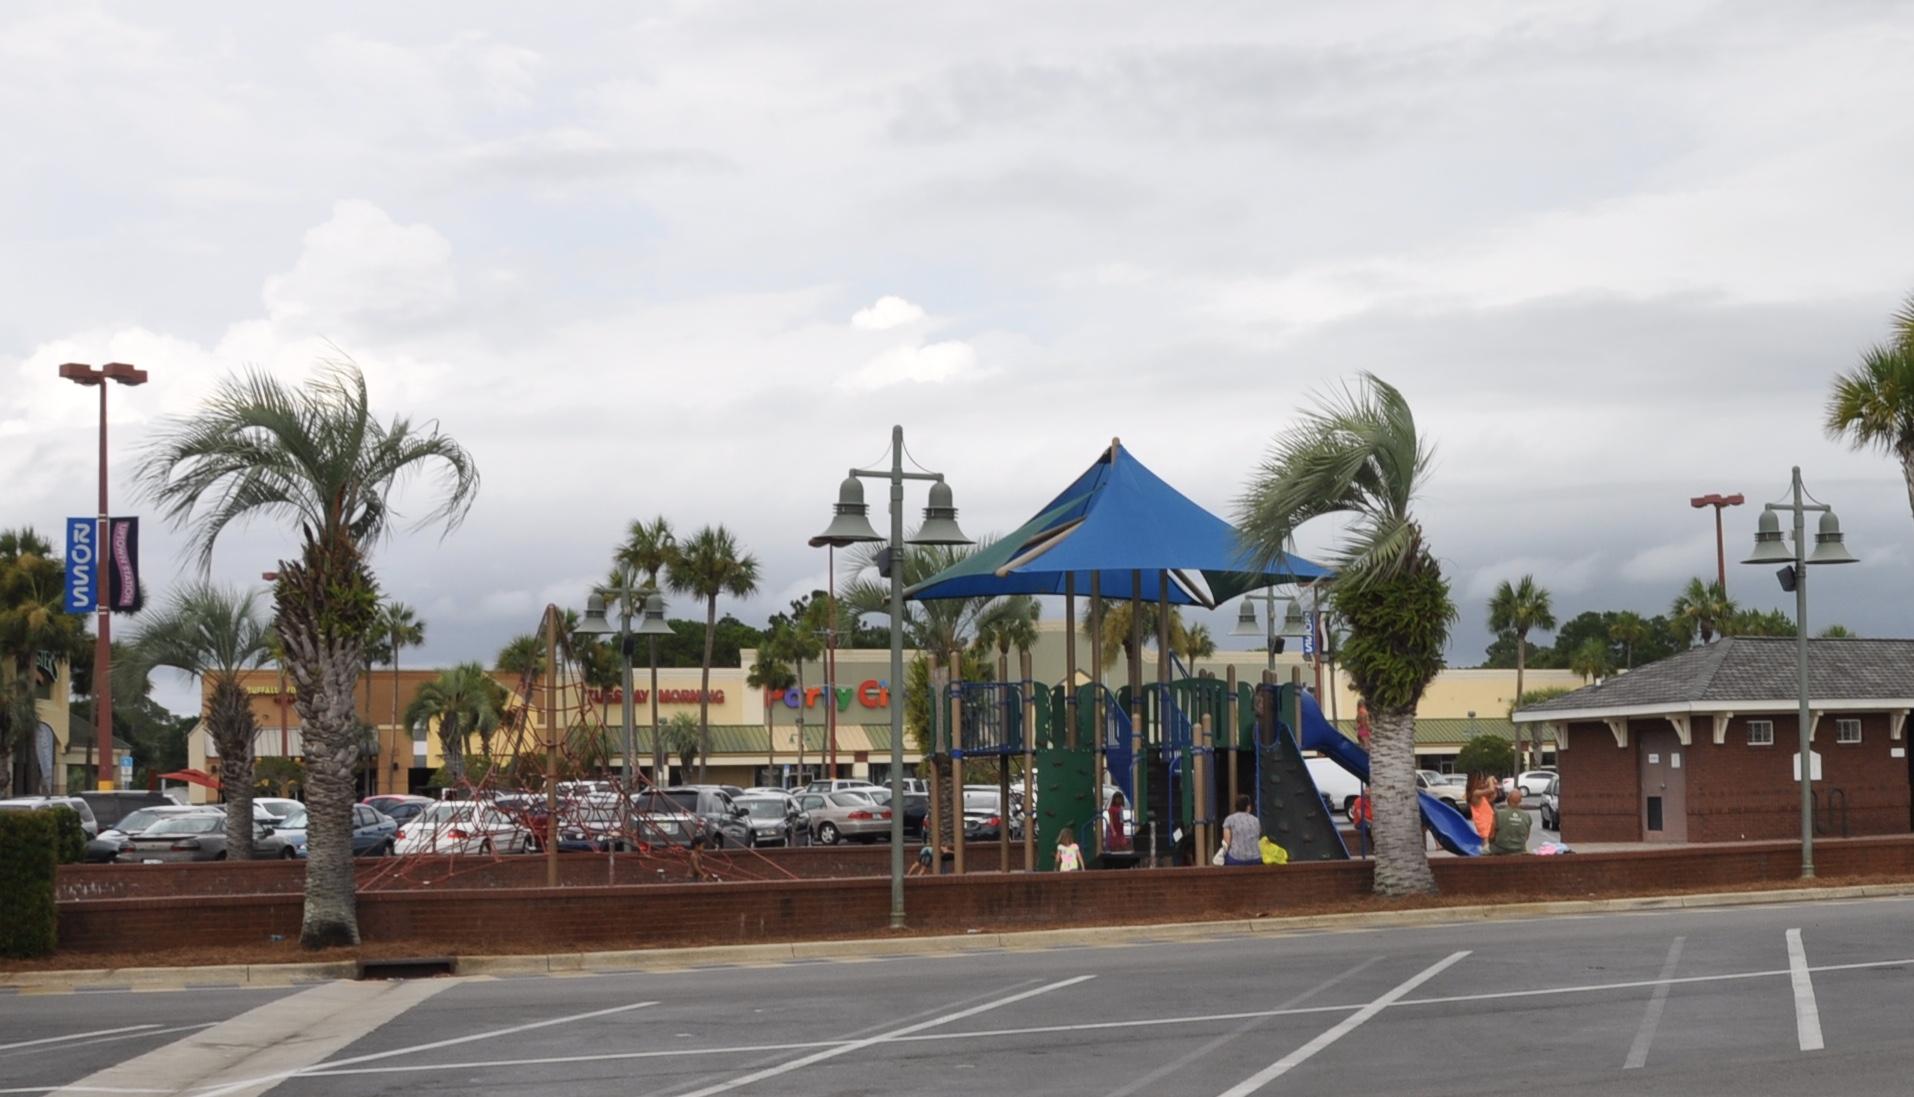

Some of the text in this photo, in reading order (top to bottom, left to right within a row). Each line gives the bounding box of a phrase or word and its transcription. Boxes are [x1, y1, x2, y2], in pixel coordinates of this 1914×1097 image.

[71, 523, 92, 607] ROSS
[587, 689, 725, 705] TUESAY MORNNG
